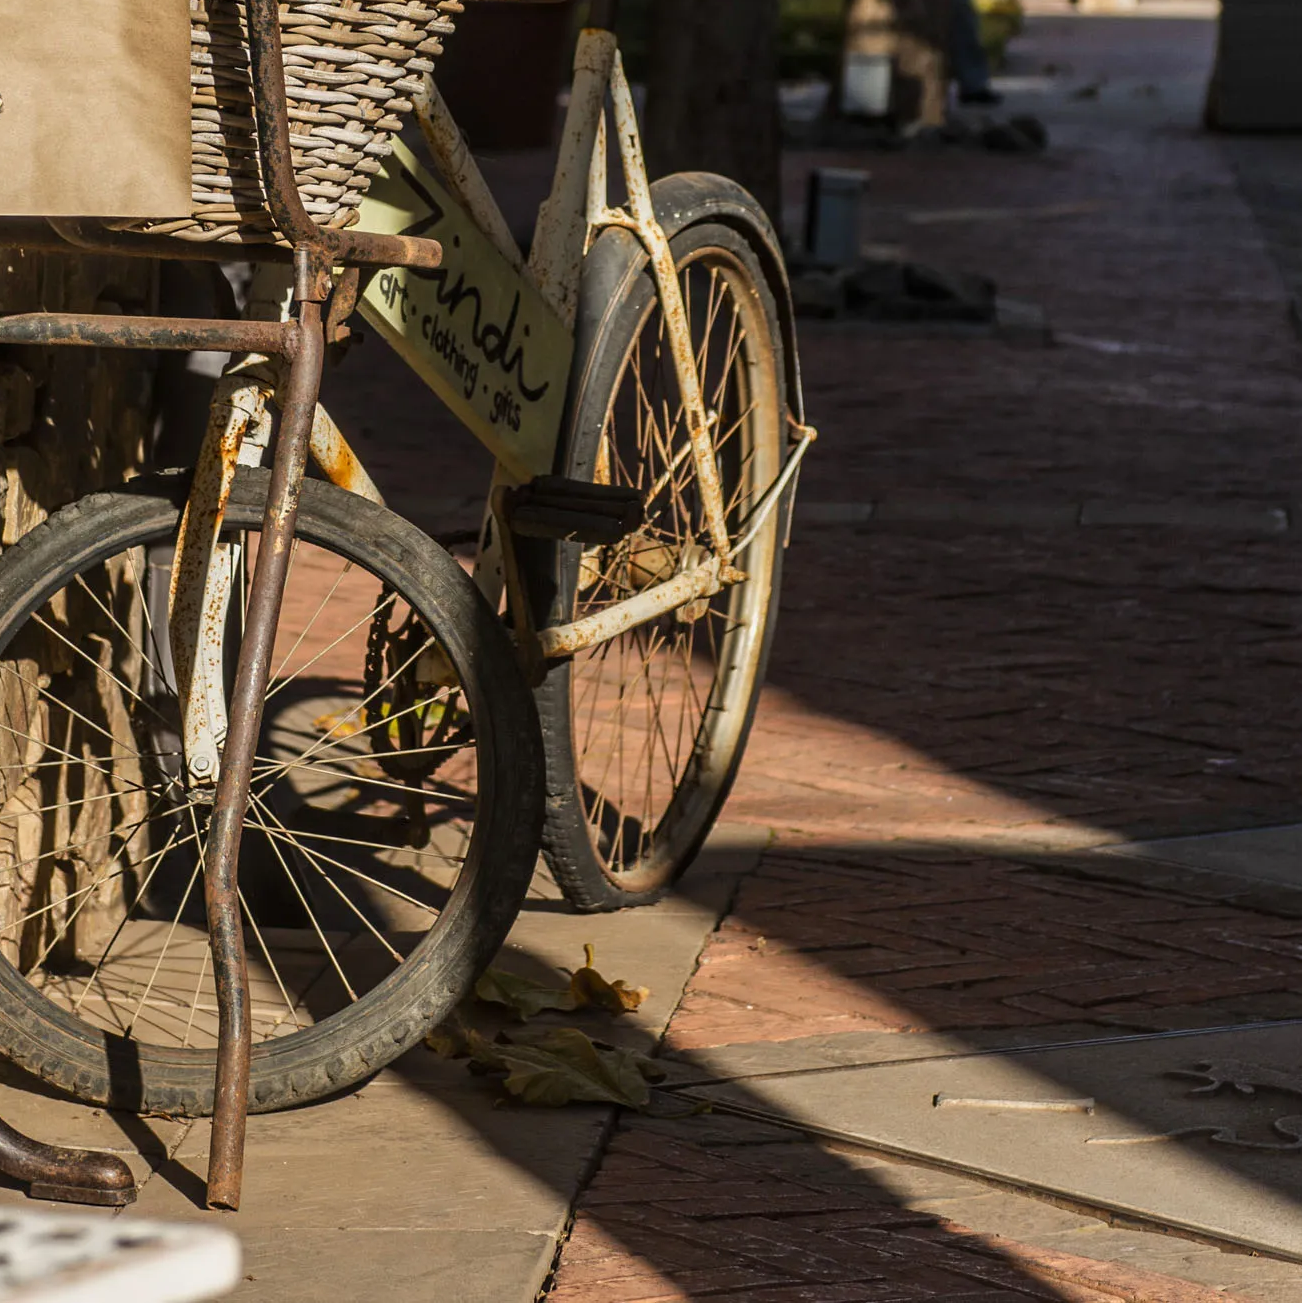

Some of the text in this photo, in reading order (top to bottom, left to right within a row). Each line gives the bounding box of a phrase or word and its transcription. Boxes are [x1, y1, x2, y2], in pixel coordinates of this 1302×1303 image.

[379, 272, 522, 433] art clothing gifts
